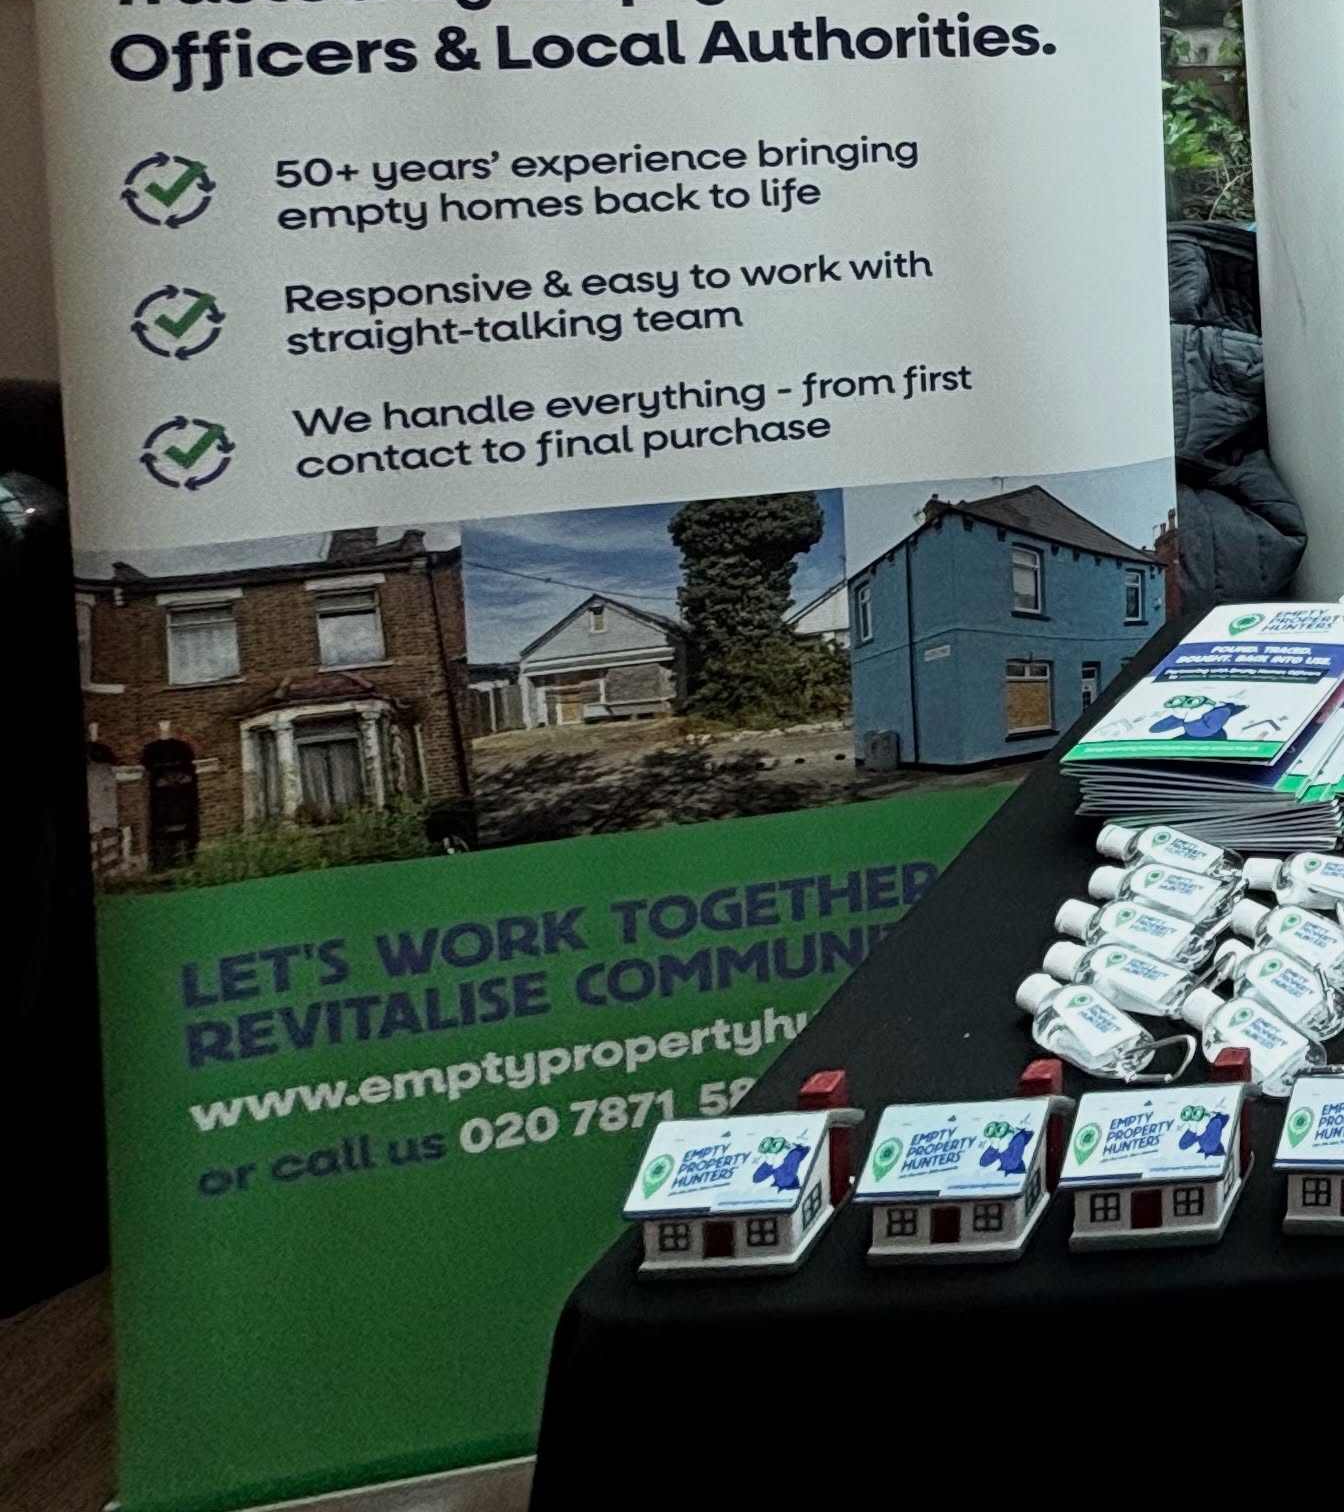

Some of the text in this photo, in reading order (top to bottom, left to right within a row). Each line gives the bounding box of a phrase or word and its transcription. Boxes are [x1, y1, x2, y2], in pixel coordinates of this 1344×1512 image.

[110, 12, 1056, 92] Officers & Local Authorities.
[276, 136, 917, 191] 50+ years' experience bringing
[278, 178, 820, 233] empty homes back to life
[285, 251, 933, 315] Responsive & easy to work with
[288, 307, 743, 355] straight-talking team
[292, 365, 972, 436] We handle everything from first
[297, 417, 830, 478] contact to final purchase
[181, 939, 350, 1009] LET'S
[374, 907, 589, 978] WORK
[186, 971, 552, 1069] REVITALISE
[197, 1163, 256, 1196] or
[270, 1134, 374, 1182] call
[387, 1133, 448, 1166] us
[460, 1107, 559, 1153] 020
[570, 1089, 675, 1136] 7871
[906, 1135, 977, 1157] PROPERTY
[911, 1127, 957, 1146] EMPTY
